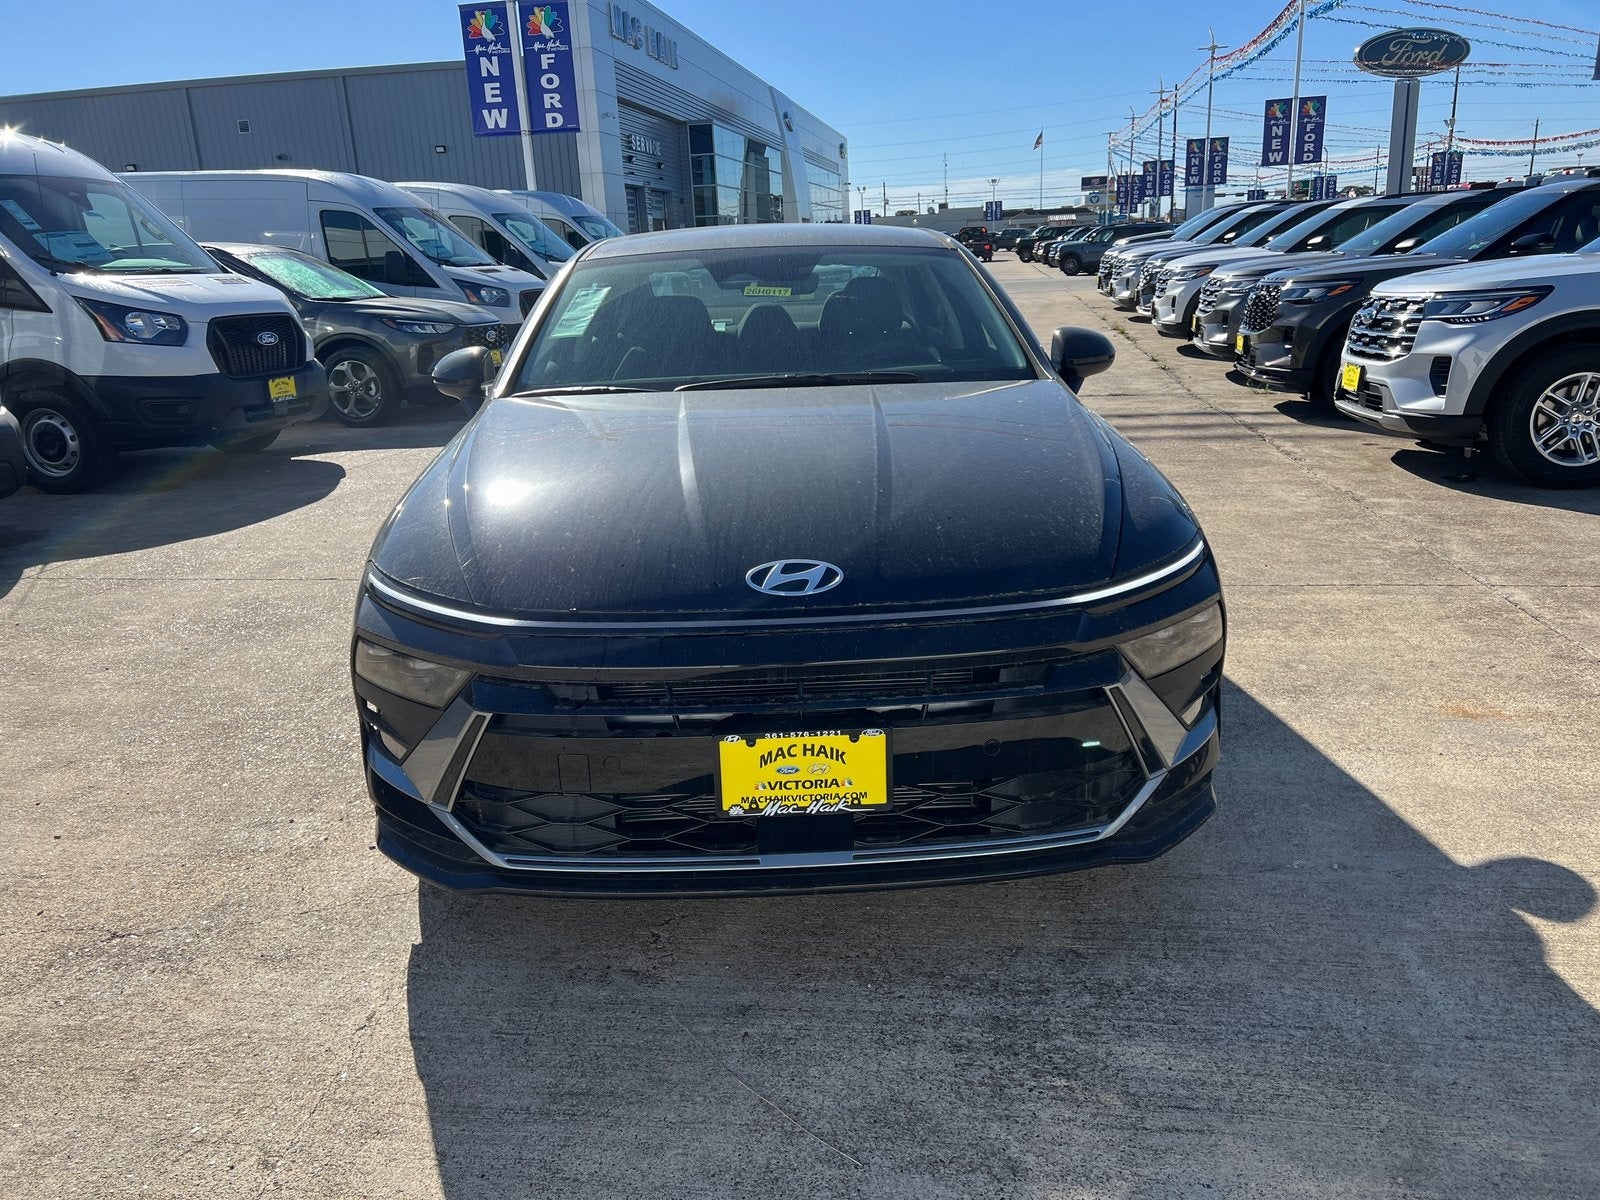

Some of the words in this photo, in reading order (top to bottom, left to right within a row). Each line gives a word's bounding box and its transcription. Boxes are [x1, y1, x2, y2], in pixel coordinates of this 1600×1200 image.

[1381, 38, 1448, 66] Ford
[480, 56, 508, 129] NEW
[540, 53, 564, 128] FORD
[631, 134, 661, 156] SERVICE
[1268, 125, 1283, 163] NEW
[1303, 123, 1316, 161] FORD
[1189, 157, 1200, 184] NEW
[1213, 155, 1222, 183] FORD
[1145, 175, 1153, 195] NEW
[764, 730, 841, 739] 361-576-1221
[760, 744, 798, 769] MAC
[802, 743, 847, 765] HAIK
[778, 766, 798, 774] Ford
[741, 791, 868, 804] MACHAIKVICTORIA.COM
[767, 778, 841, 791] VICTORIA
[761, 799, 804, 817] Mac
[805, 797, 858, 815] Haik
